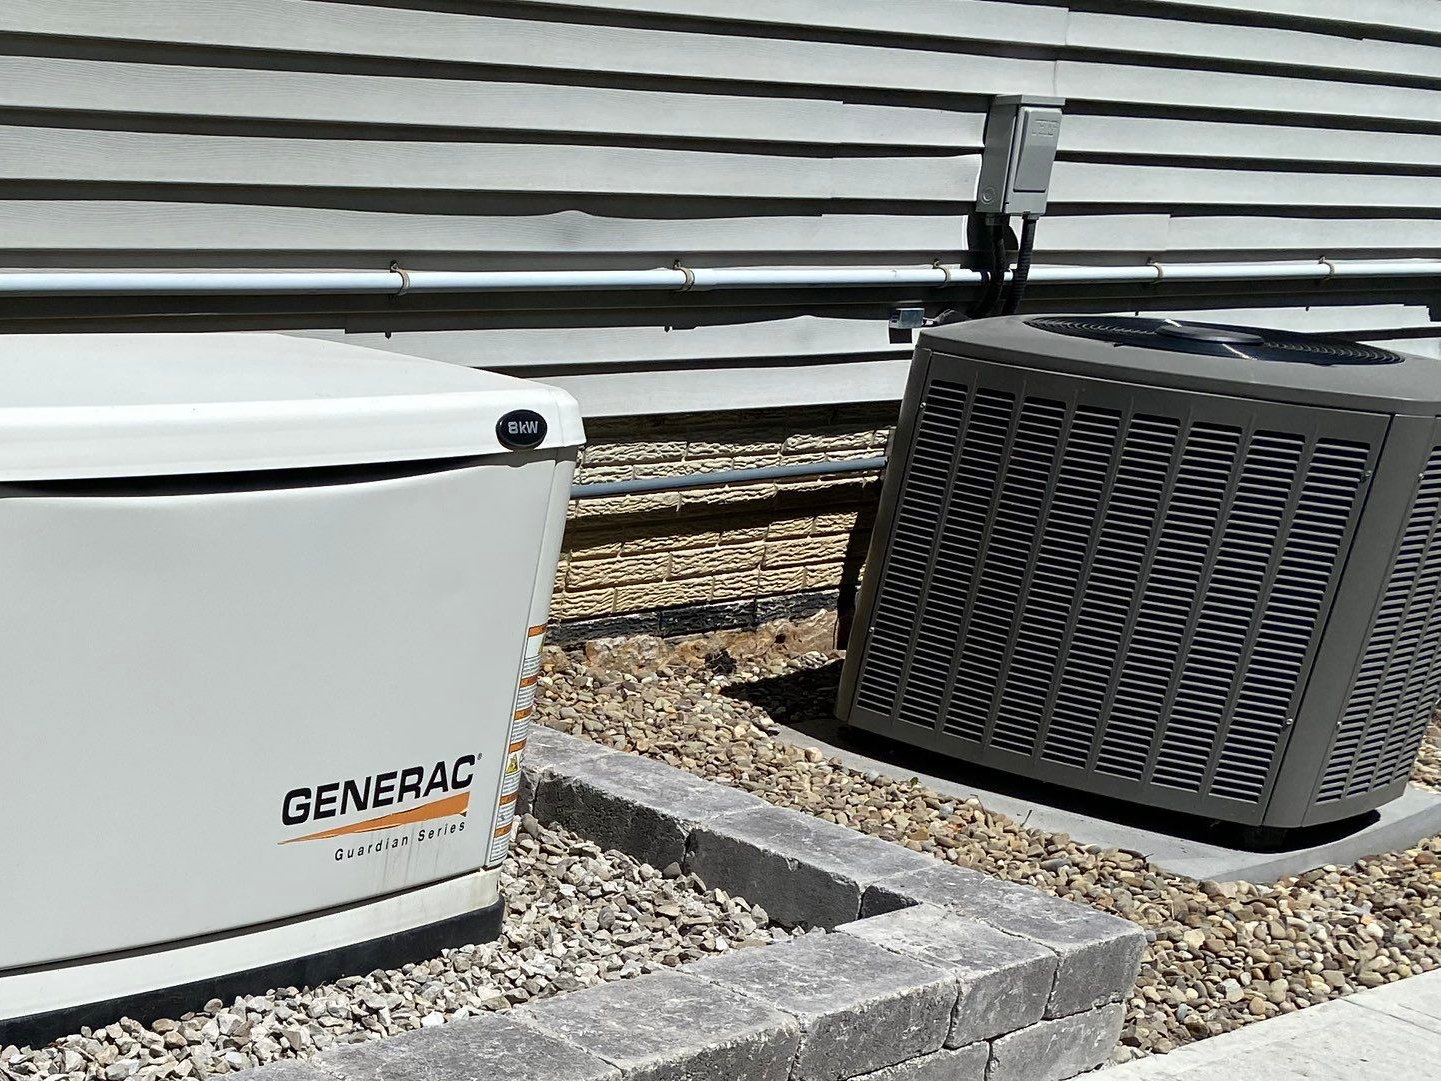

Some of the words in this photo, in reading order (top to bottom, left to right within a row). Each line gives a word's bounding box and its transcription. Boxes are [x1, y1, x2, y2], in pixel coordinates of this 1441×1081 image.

[281, 754, 476, 826] GENERAC
[334, 835, 409, 861] Guardian
[417, 821, 466, 842] Series
